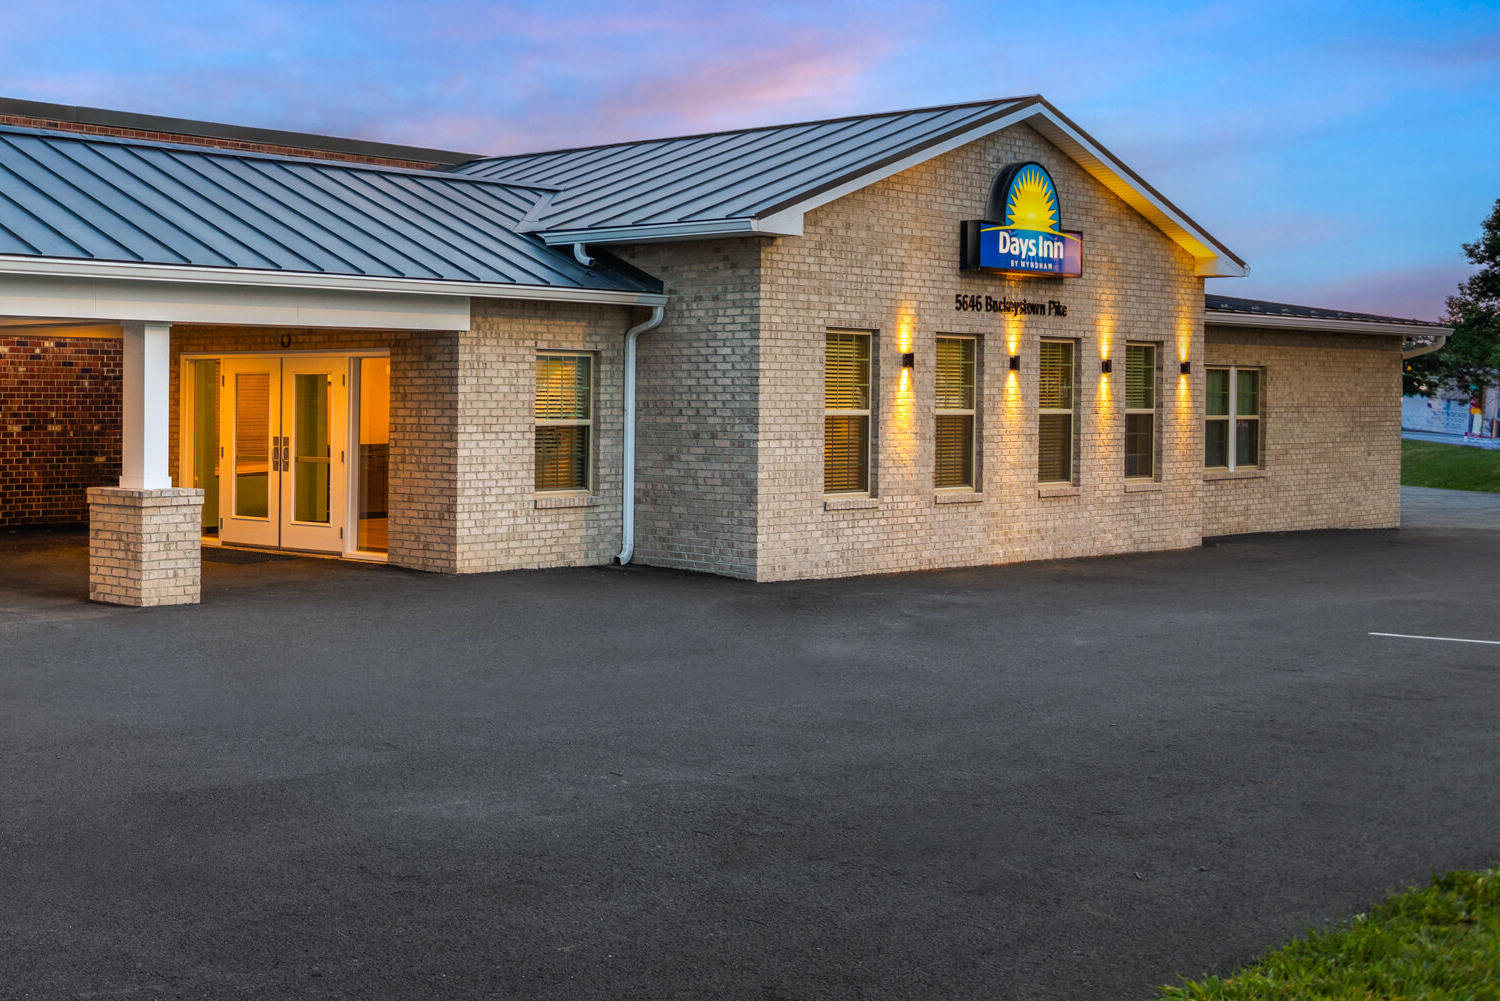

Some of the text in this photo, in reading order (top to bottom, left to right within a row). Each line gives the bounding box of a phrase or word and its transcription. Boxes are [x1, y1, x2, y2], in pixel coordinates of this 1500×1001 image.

[999, 231, 1064, 259] Days Inn
[1020, 261, 1053, 270] WYNDHAM
[955, 294, 982, 312] 5646
[1048, 300, 1068, 317] Pike
